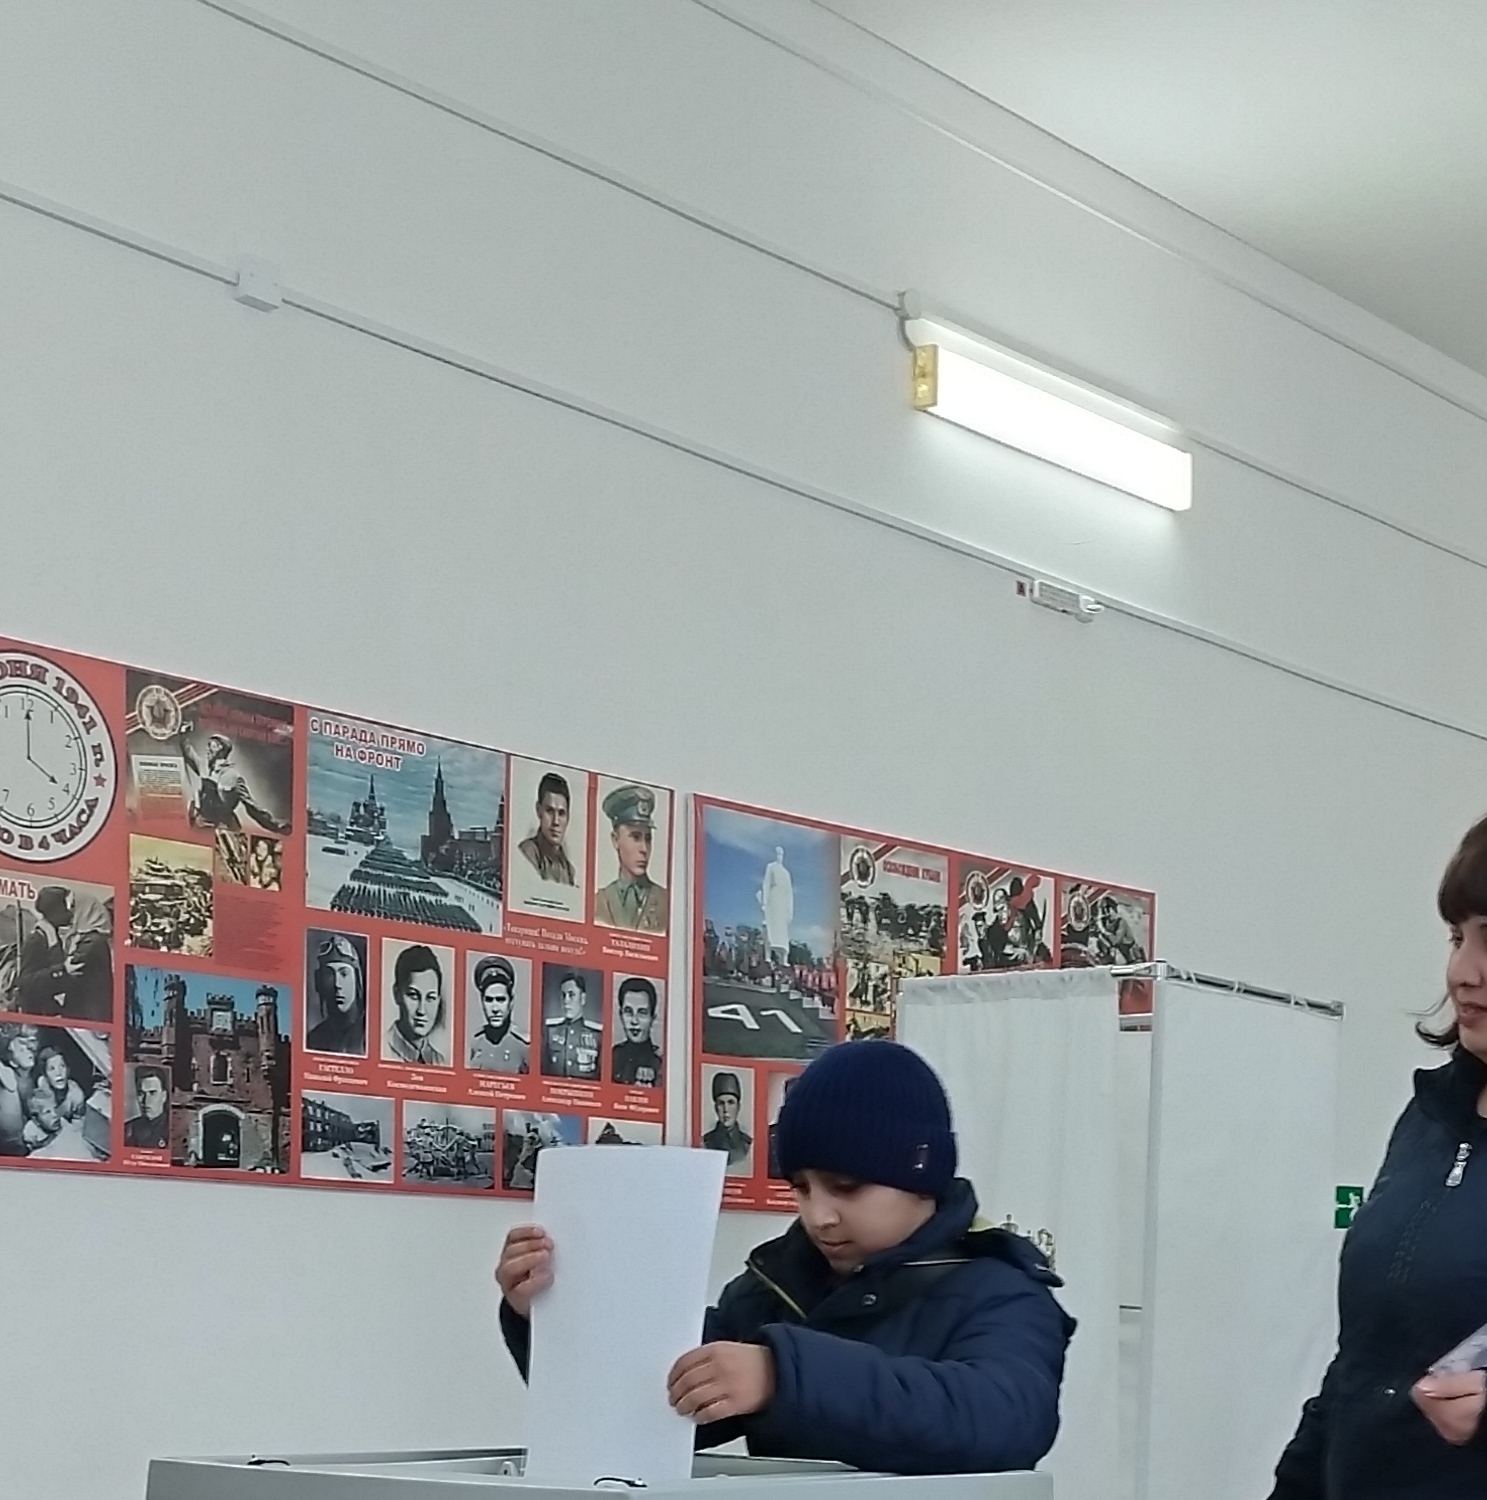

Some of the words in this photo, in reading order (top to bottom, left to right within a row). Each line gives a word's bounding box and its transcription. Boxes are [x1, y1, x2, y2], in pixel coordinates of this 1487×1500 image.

[53, 676, 97, 735] 1941
[65, 734, 72, 749] 2
[310, 718, 319, 732] С
[323, 721, 377, 744] ПАРАДА
[380, 734, 425, 756] ПРЯМО
[335, 743, 353, 760] НА
[356, 749, 402, 770] ФРОНТ
[70, 763, 77, 776] 3
[62, 783, 70, 795] 4
[26, 802, 35, 817] 6
[48, 797, 55, 811] 5
[18, 834, 34, 851] В
[38, 834, 50, 851] 4
[51, 798, 99, 845] ЧАСА
